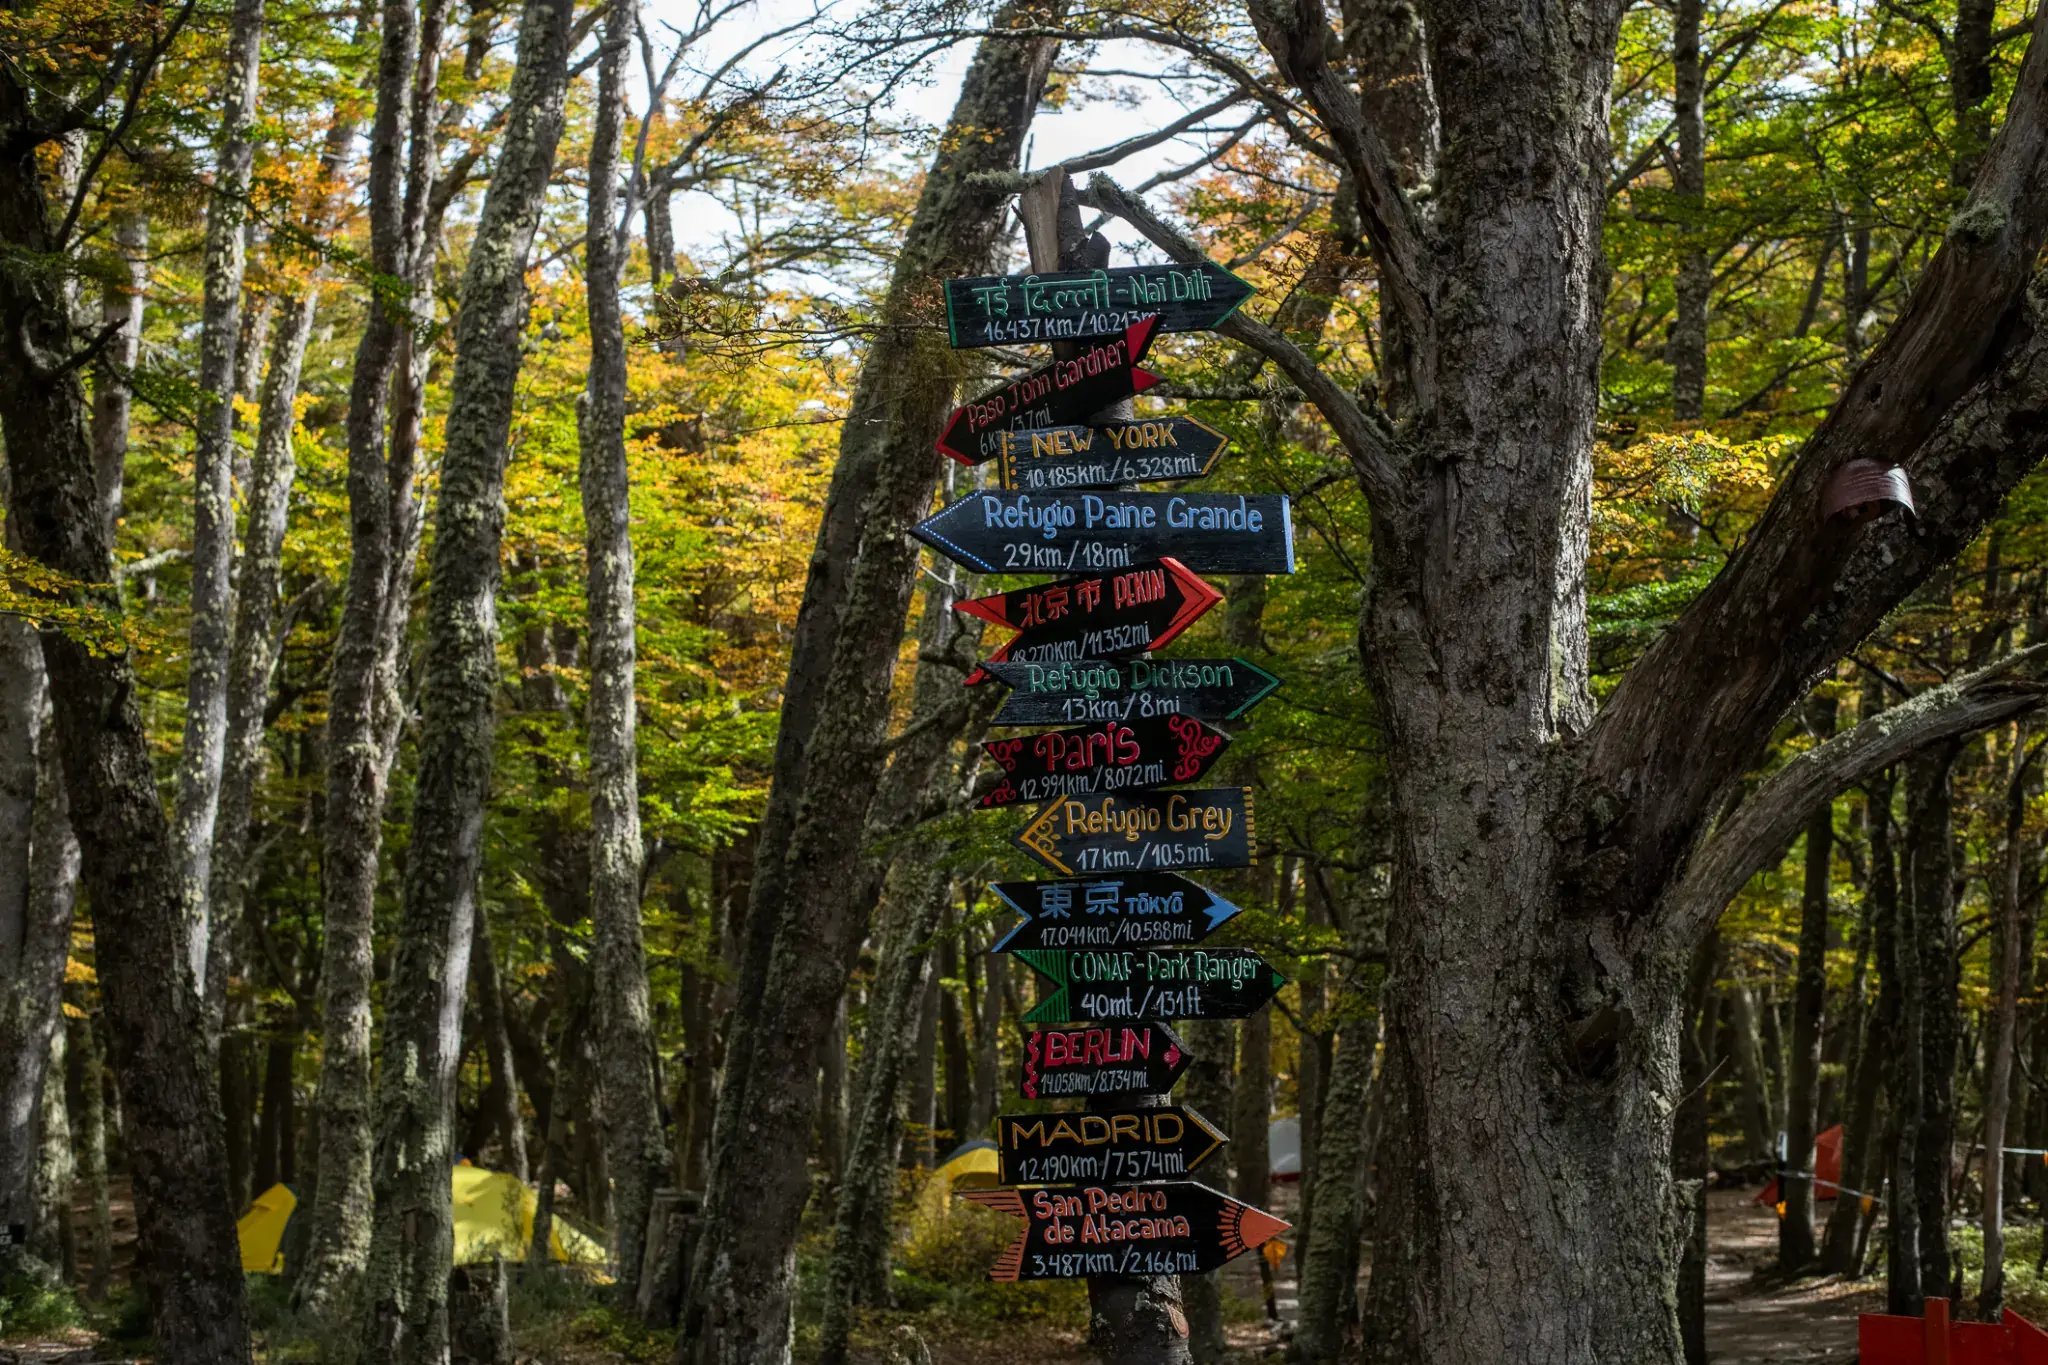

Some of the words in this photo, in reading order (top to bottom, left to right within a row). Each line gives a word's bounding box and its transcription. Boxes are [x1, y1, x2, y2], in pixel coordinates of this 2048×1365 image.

[967, 396, 1006, 433] Paso
[1007, 372, 1051, 413] John
[1054, 339, 1126, 391] Gardner
[1032, 428, 1094, 458] NEW
[1106, 422, 1178, 450] YORK
[982, 495, 1075, 539] Refugio
[1083, 494, 1156, 529] Paine
[1167, 495, 1263, 532] Grande
[1019, 578, 1103, 628] 北京市
[1113, 569, 1167, 610] PEKIN
[1024, 662, 1120, 700] Refugio
[1129, 661, 1233, 690] Dickson
[1034, 722, 1141, 772] Paris
[1064, 797, 1161, 842] Refugio
[1167, 795, 1232, 840] Grey
[1037, 880, 1124, 920] 東京
[1069, 952, 1133, 982] CONAF
[1147, 952, 1189, 982] Park
[1194, 951, 1262, 991] Ranger
[1044, 1027, 1151, 1068] BERLIN
[1012, 1113, 1184, 1150] MADRID
[1032, 1191, 1083, 1220] San
[1084, 1186, 1167, 1215] Pedro
[1044, 1217, 1075, 1245] de
[1081, 1214, 1190, 1244] Atacama
